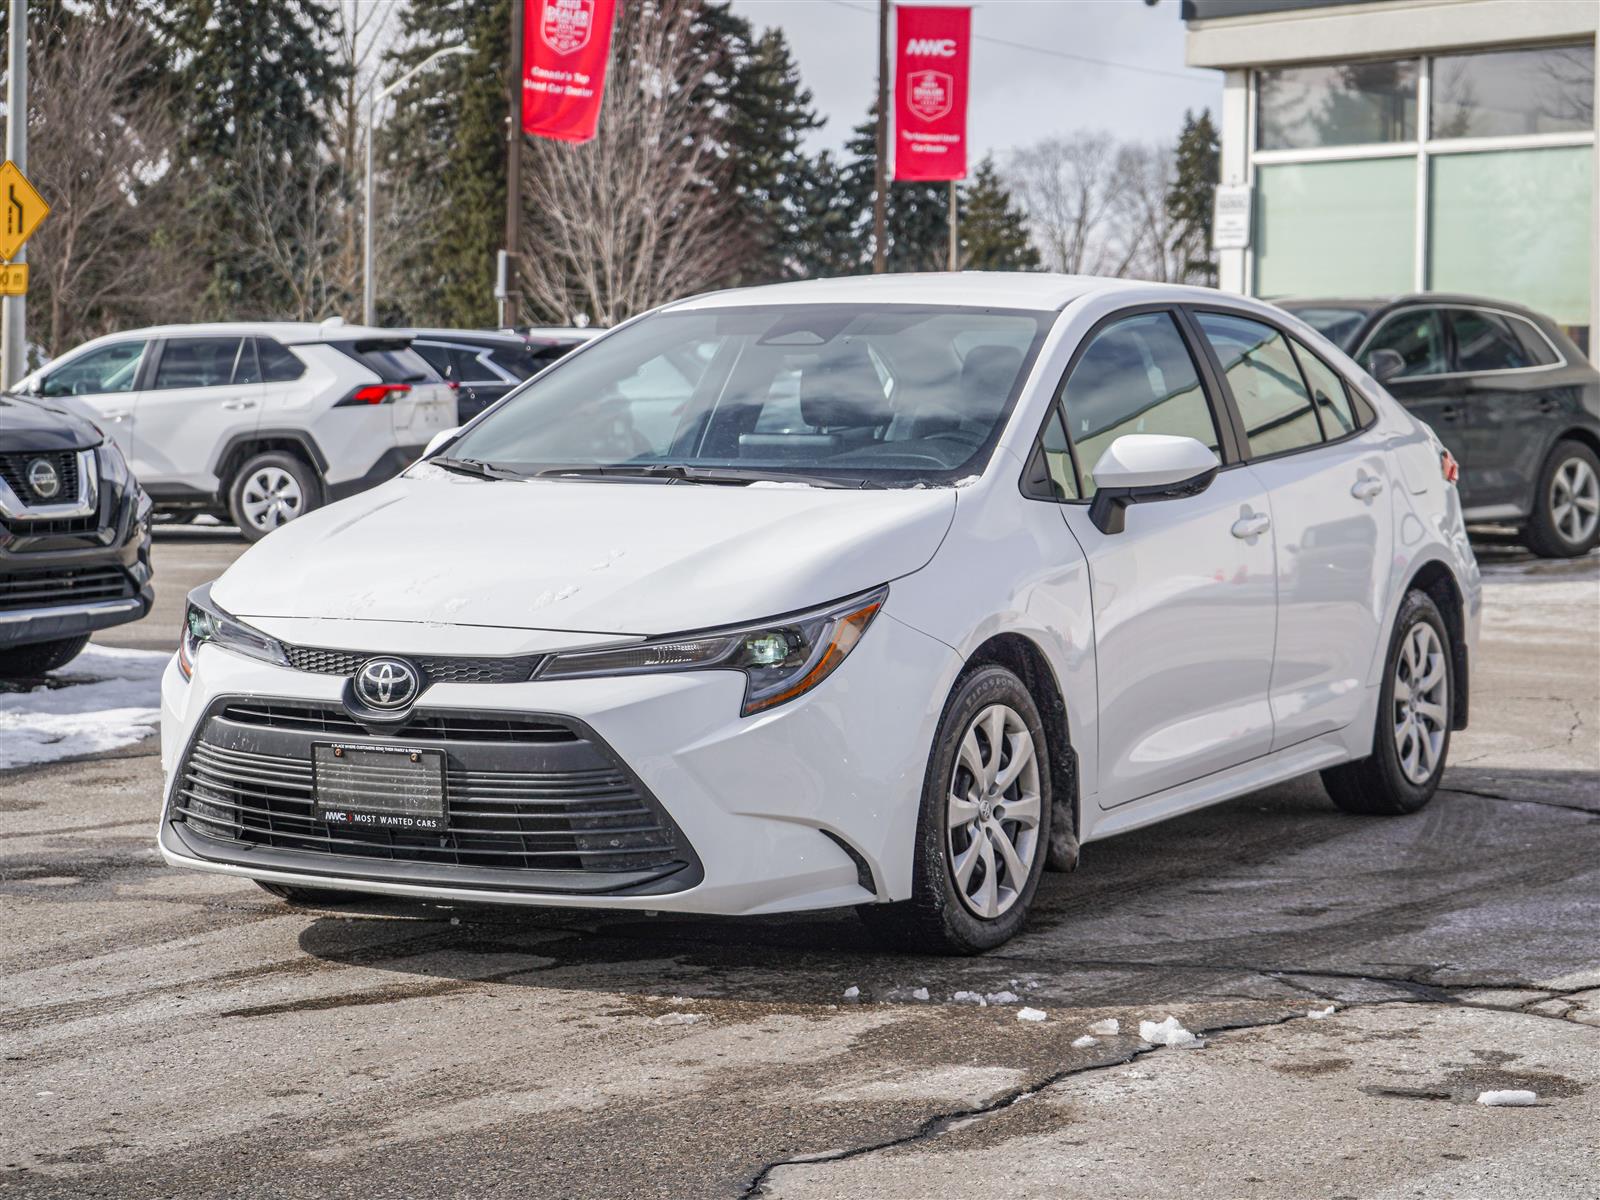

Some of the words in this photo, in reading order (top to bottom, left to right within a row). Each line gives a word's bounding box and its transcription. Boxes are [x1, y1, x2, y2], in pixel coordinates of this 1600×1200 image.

[531, 66, 572, 81] Canada's
[573, 72, 590, 85] Top
[547, 83, 564, 94] Car
[564, 85, 593, 97] Dealer
[0, 271, 9, 285] 0
[354, 814, 376, 823] MOST
[380, 816, 413, 826] WANTED
[416, 819, 437, 828] CARS
